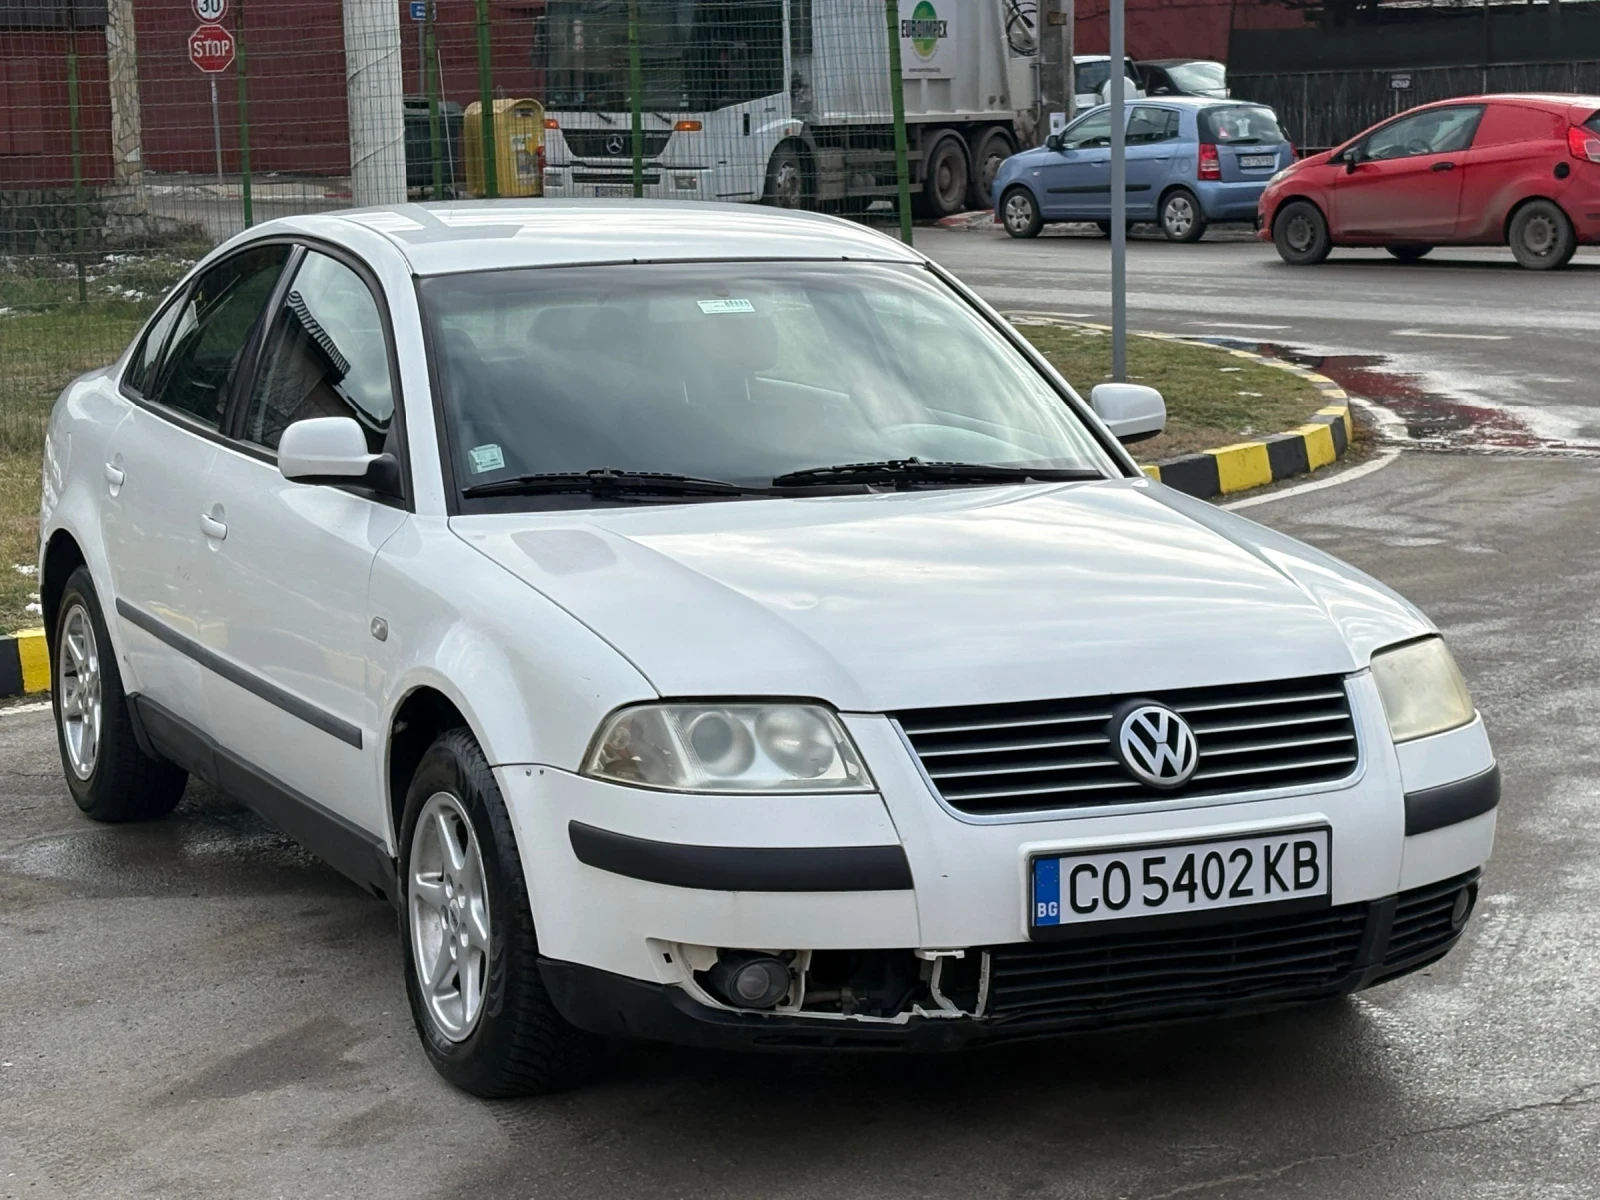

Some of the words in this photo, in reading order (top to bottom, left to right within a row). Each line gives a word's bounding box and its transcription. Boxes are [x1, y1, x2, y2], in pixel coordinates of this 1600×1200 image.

[200, 0, 220, 13] 30
[901, 19, 948, 38] EUROIMPEX
[193, 39, 230, 58] STOP
[1069, 860, 1131, 914] CO
[1142, 847, 1254, 907] 5402
[1264, 840, 1320, 894] KB
[1036, 901, 1058, 918] BG
